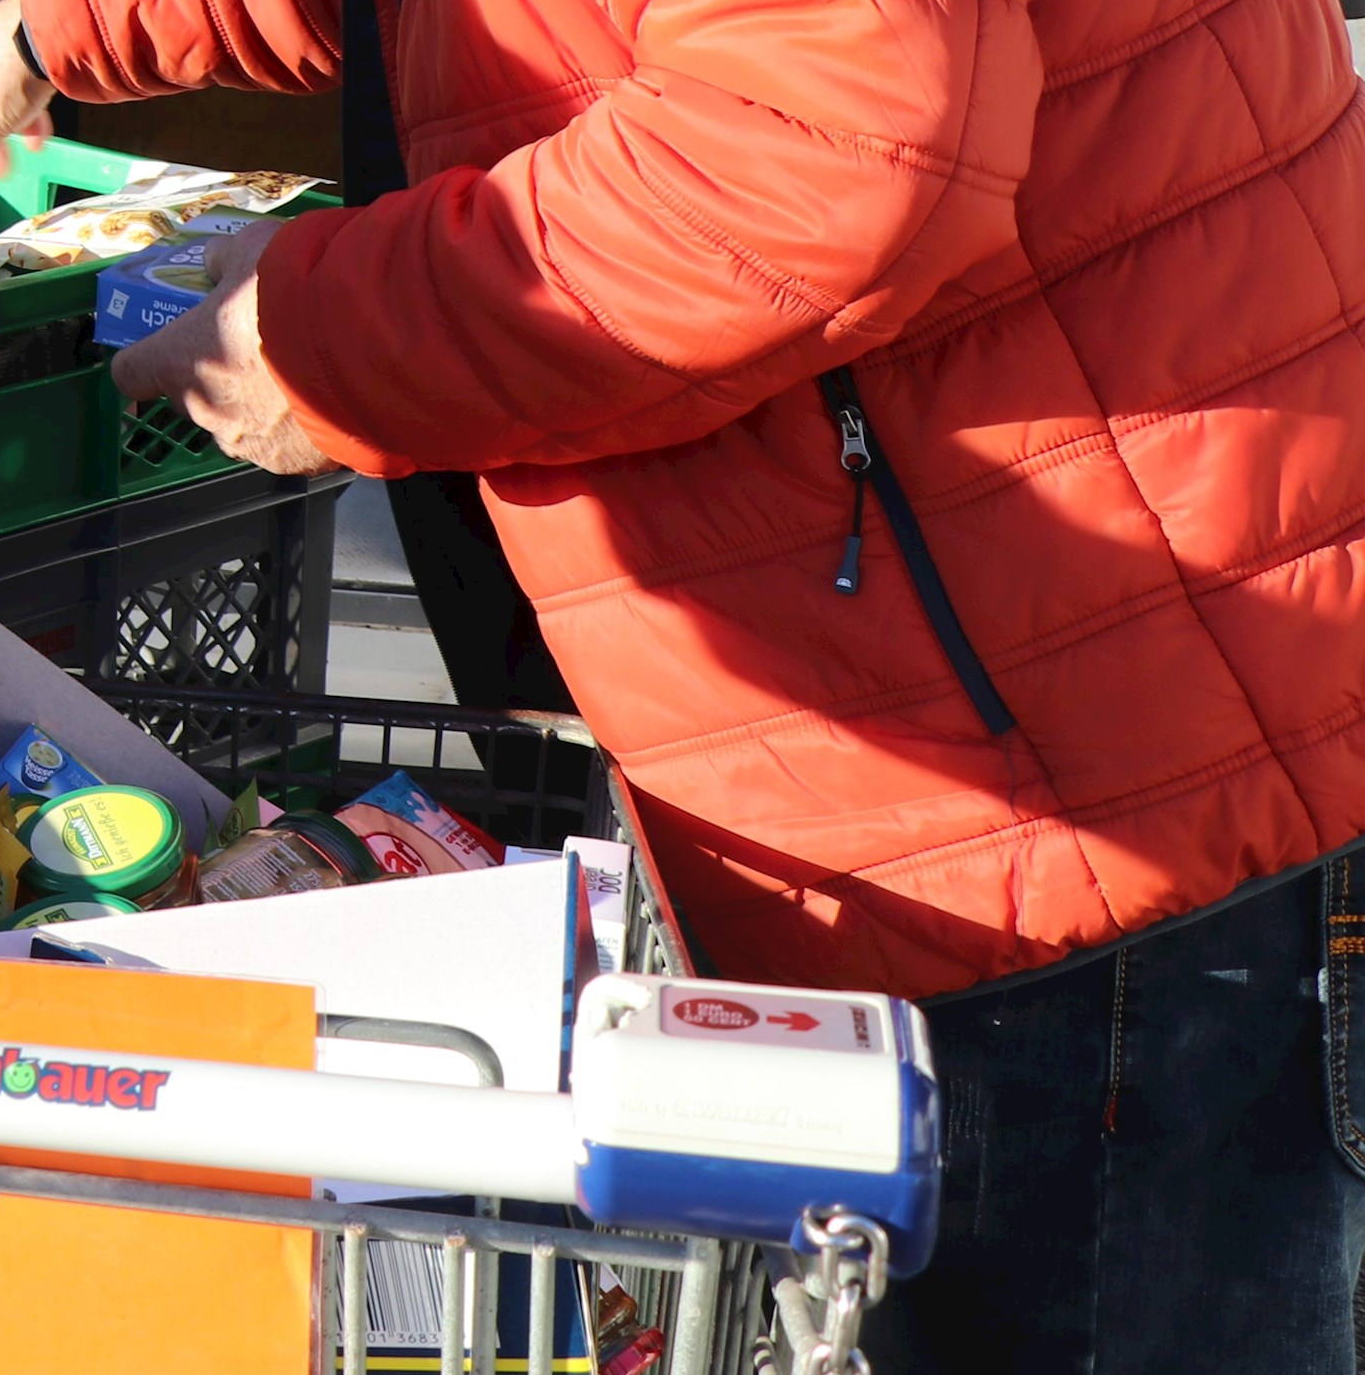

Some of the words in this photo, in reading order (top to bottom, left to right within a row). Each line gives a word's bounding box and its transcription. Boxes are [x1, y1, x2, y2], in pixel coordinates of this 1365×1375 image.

[114, 847, 133, 862] Ich
[598, 867, 622, 894] DOC
[397, 1332, 439, 1344] 3683
